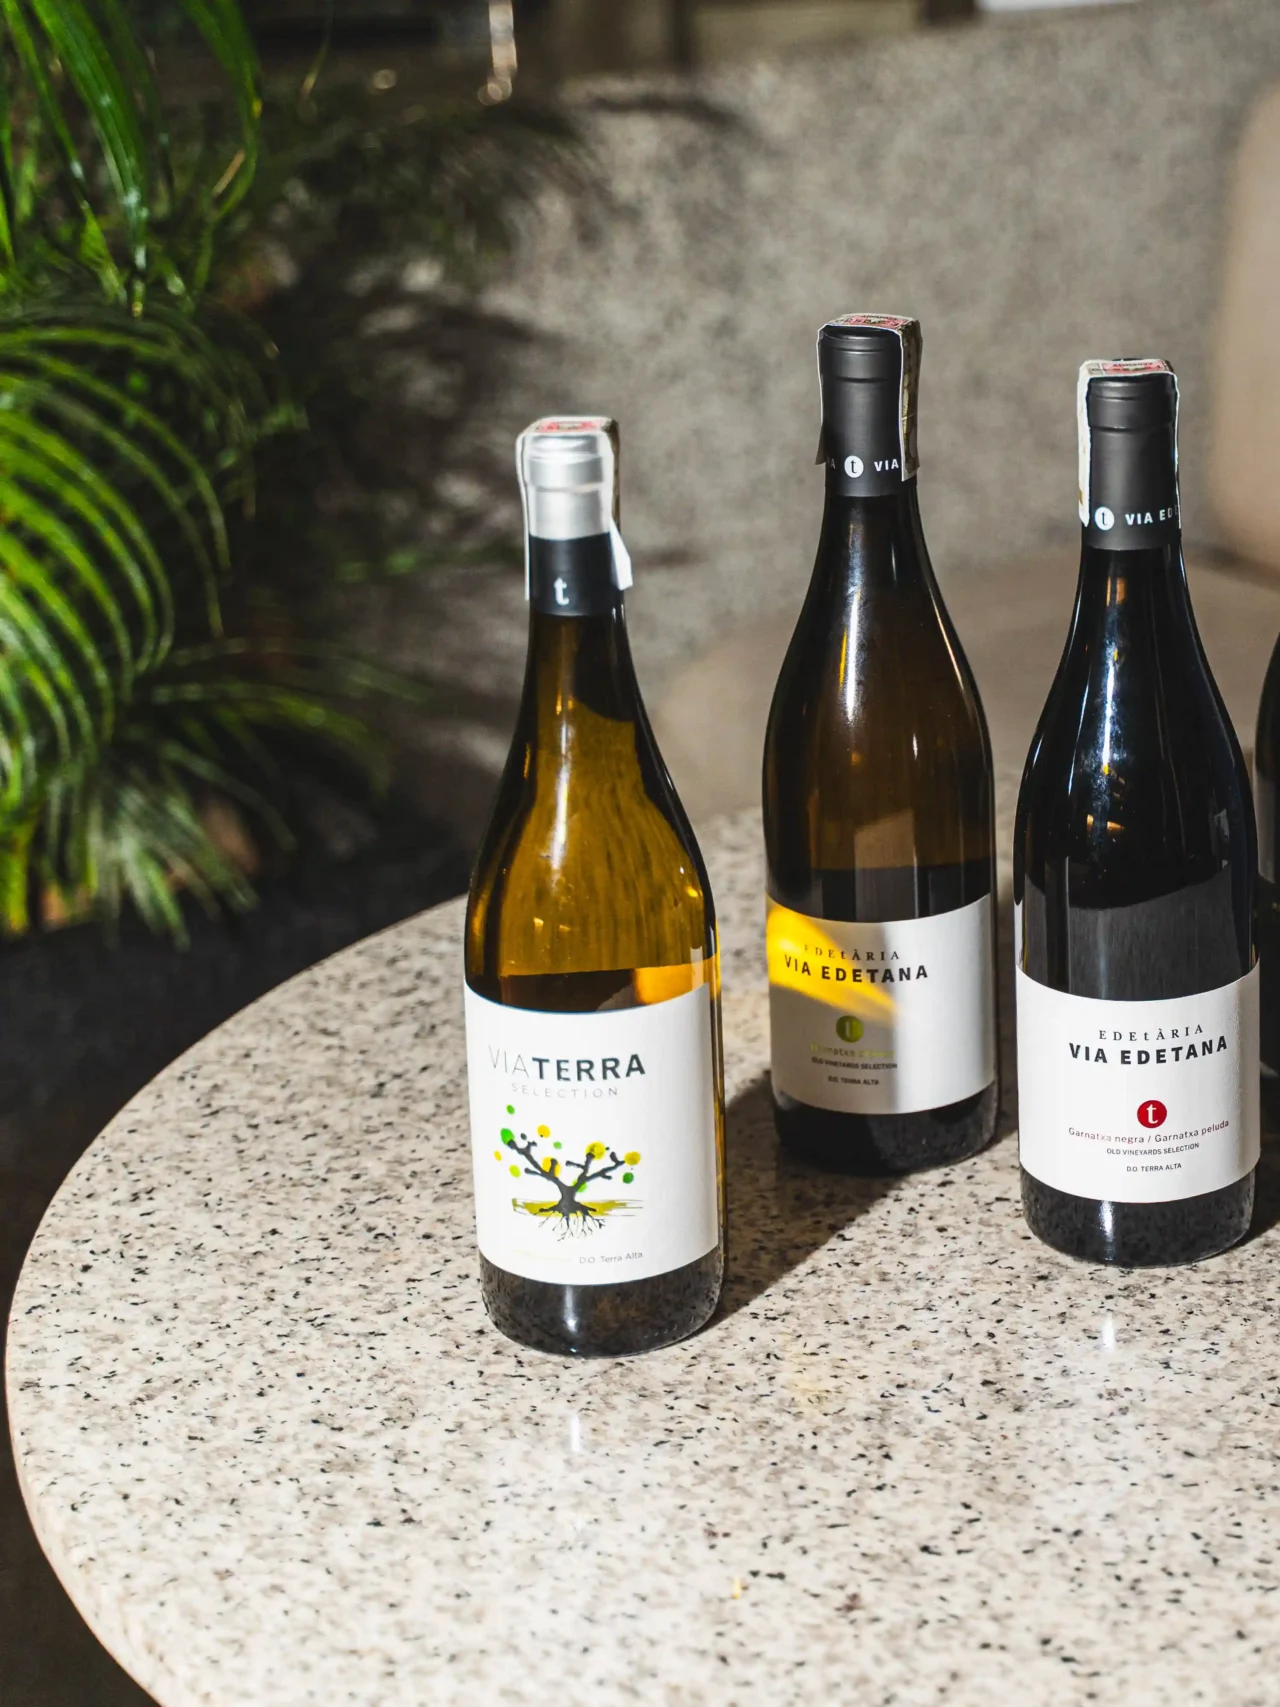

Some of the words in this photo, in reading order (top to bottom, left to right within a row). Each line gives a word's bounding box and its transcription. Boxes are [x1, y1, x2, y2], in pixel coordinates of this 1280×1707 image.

[850, 459, 857, 474] t
[874, 458, 899, 472] VIA
[1101, 511, 1108, 525] t
[1125, 513, 1153, 526] VIA
[553, 577, 570, 606] t
[784, 954, 811, 976] VIA
[821, 965, 928, 983] EDETANA
[1069, 1042, 1108, 1064] VIA
[1120, 1035, 1228, 1065] EDETANA
[511, 1083, 618, 1099] SELECTION
[1146, 1103, 1158, 1124] t
[1068, 1127, 1111, 1142] Garnatxa
[1115, 1136, 1144, 1145] negra
[1154, 1129, 1199, 1143] Garnatxa
[1201, 1119, 1229, 1136] peluda
[1122, 1148, 1162, 1156] VINEYARDS
[1163, 1142, 1200, 1155] SELECTION
[1165, 1162, 1182, 1171] ALTA
[600, 1255, 623, 1263] Terra
[625, 1251, 644, 1260] Alta
